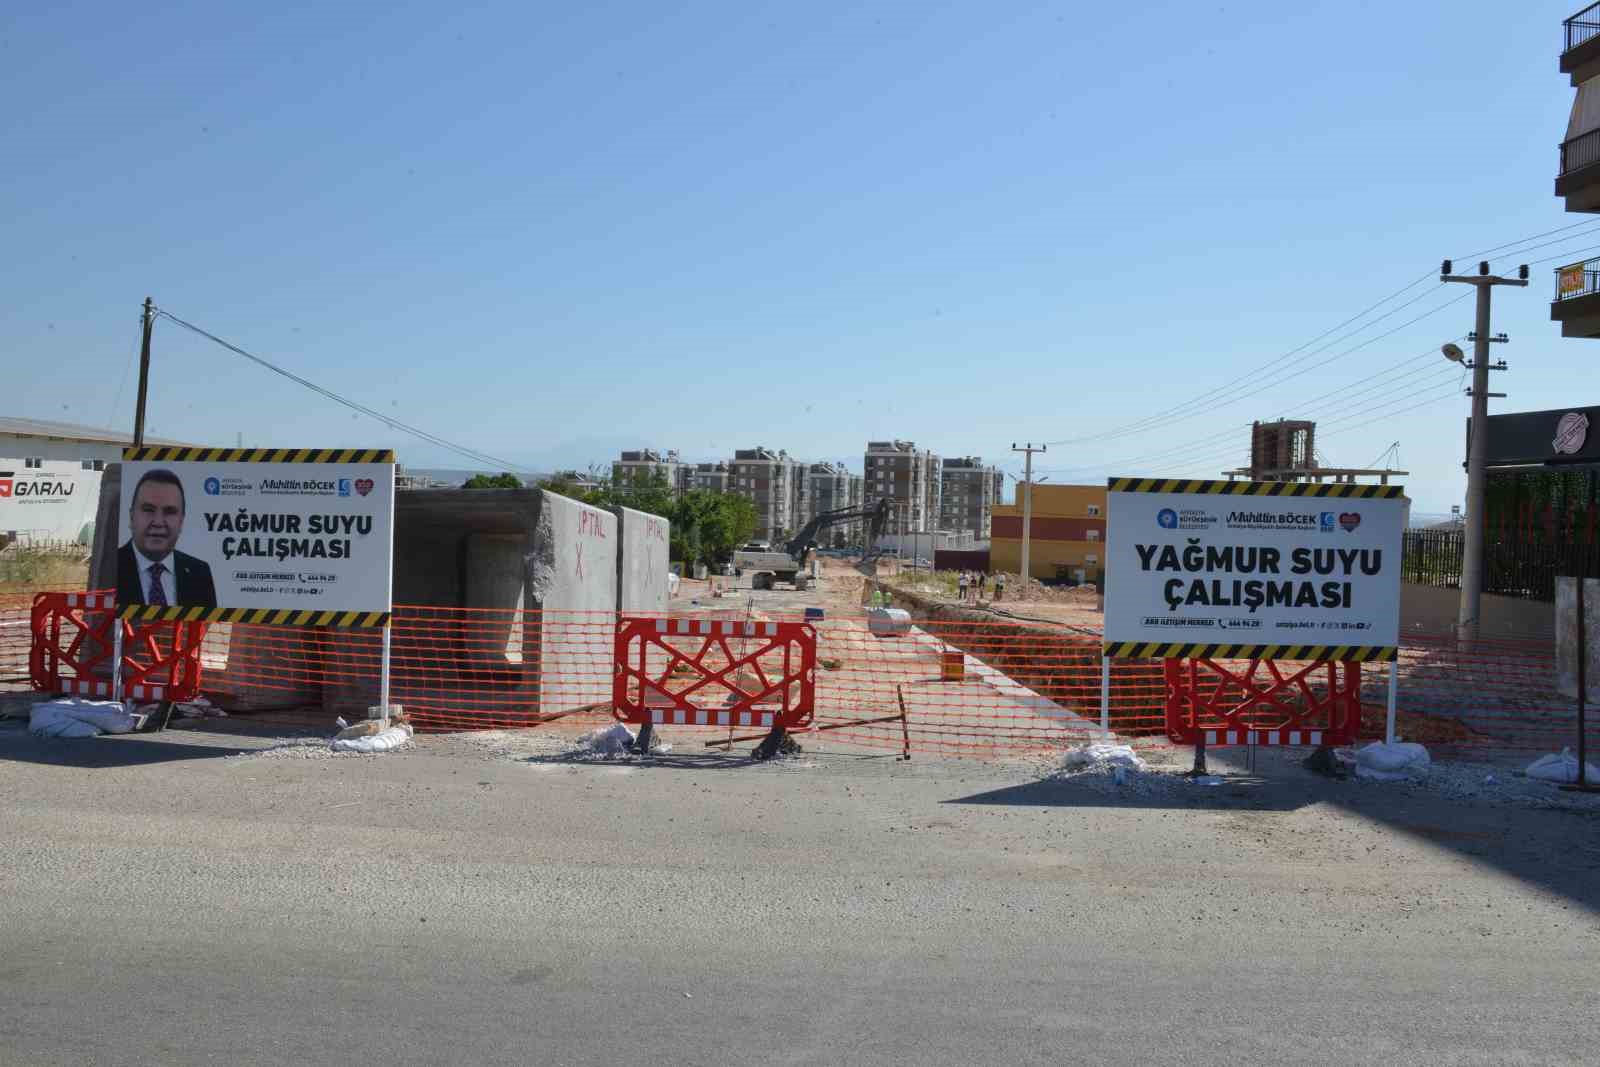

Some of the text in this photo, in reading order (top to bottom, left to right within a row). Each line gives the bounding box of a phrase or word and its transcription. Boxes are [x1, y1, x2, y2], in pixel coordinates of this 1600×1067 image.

[15, 481, 75, 496] GARAJ
[260, 479, 301, 490] Muhittin
[303, 479, 336, 490] BÖCEK
[204, 508, 373, 535] YAĞMUR SUYU
[1226, 511, 1317, 524] Muhittin BÖCEK
[222, 536, 351, 562] ÇALIŞMASI
[1135, 538, 1382, 576] YAĞMUR SUYU
[1164, 578, 1352, 613] ÇALIŞMASI
